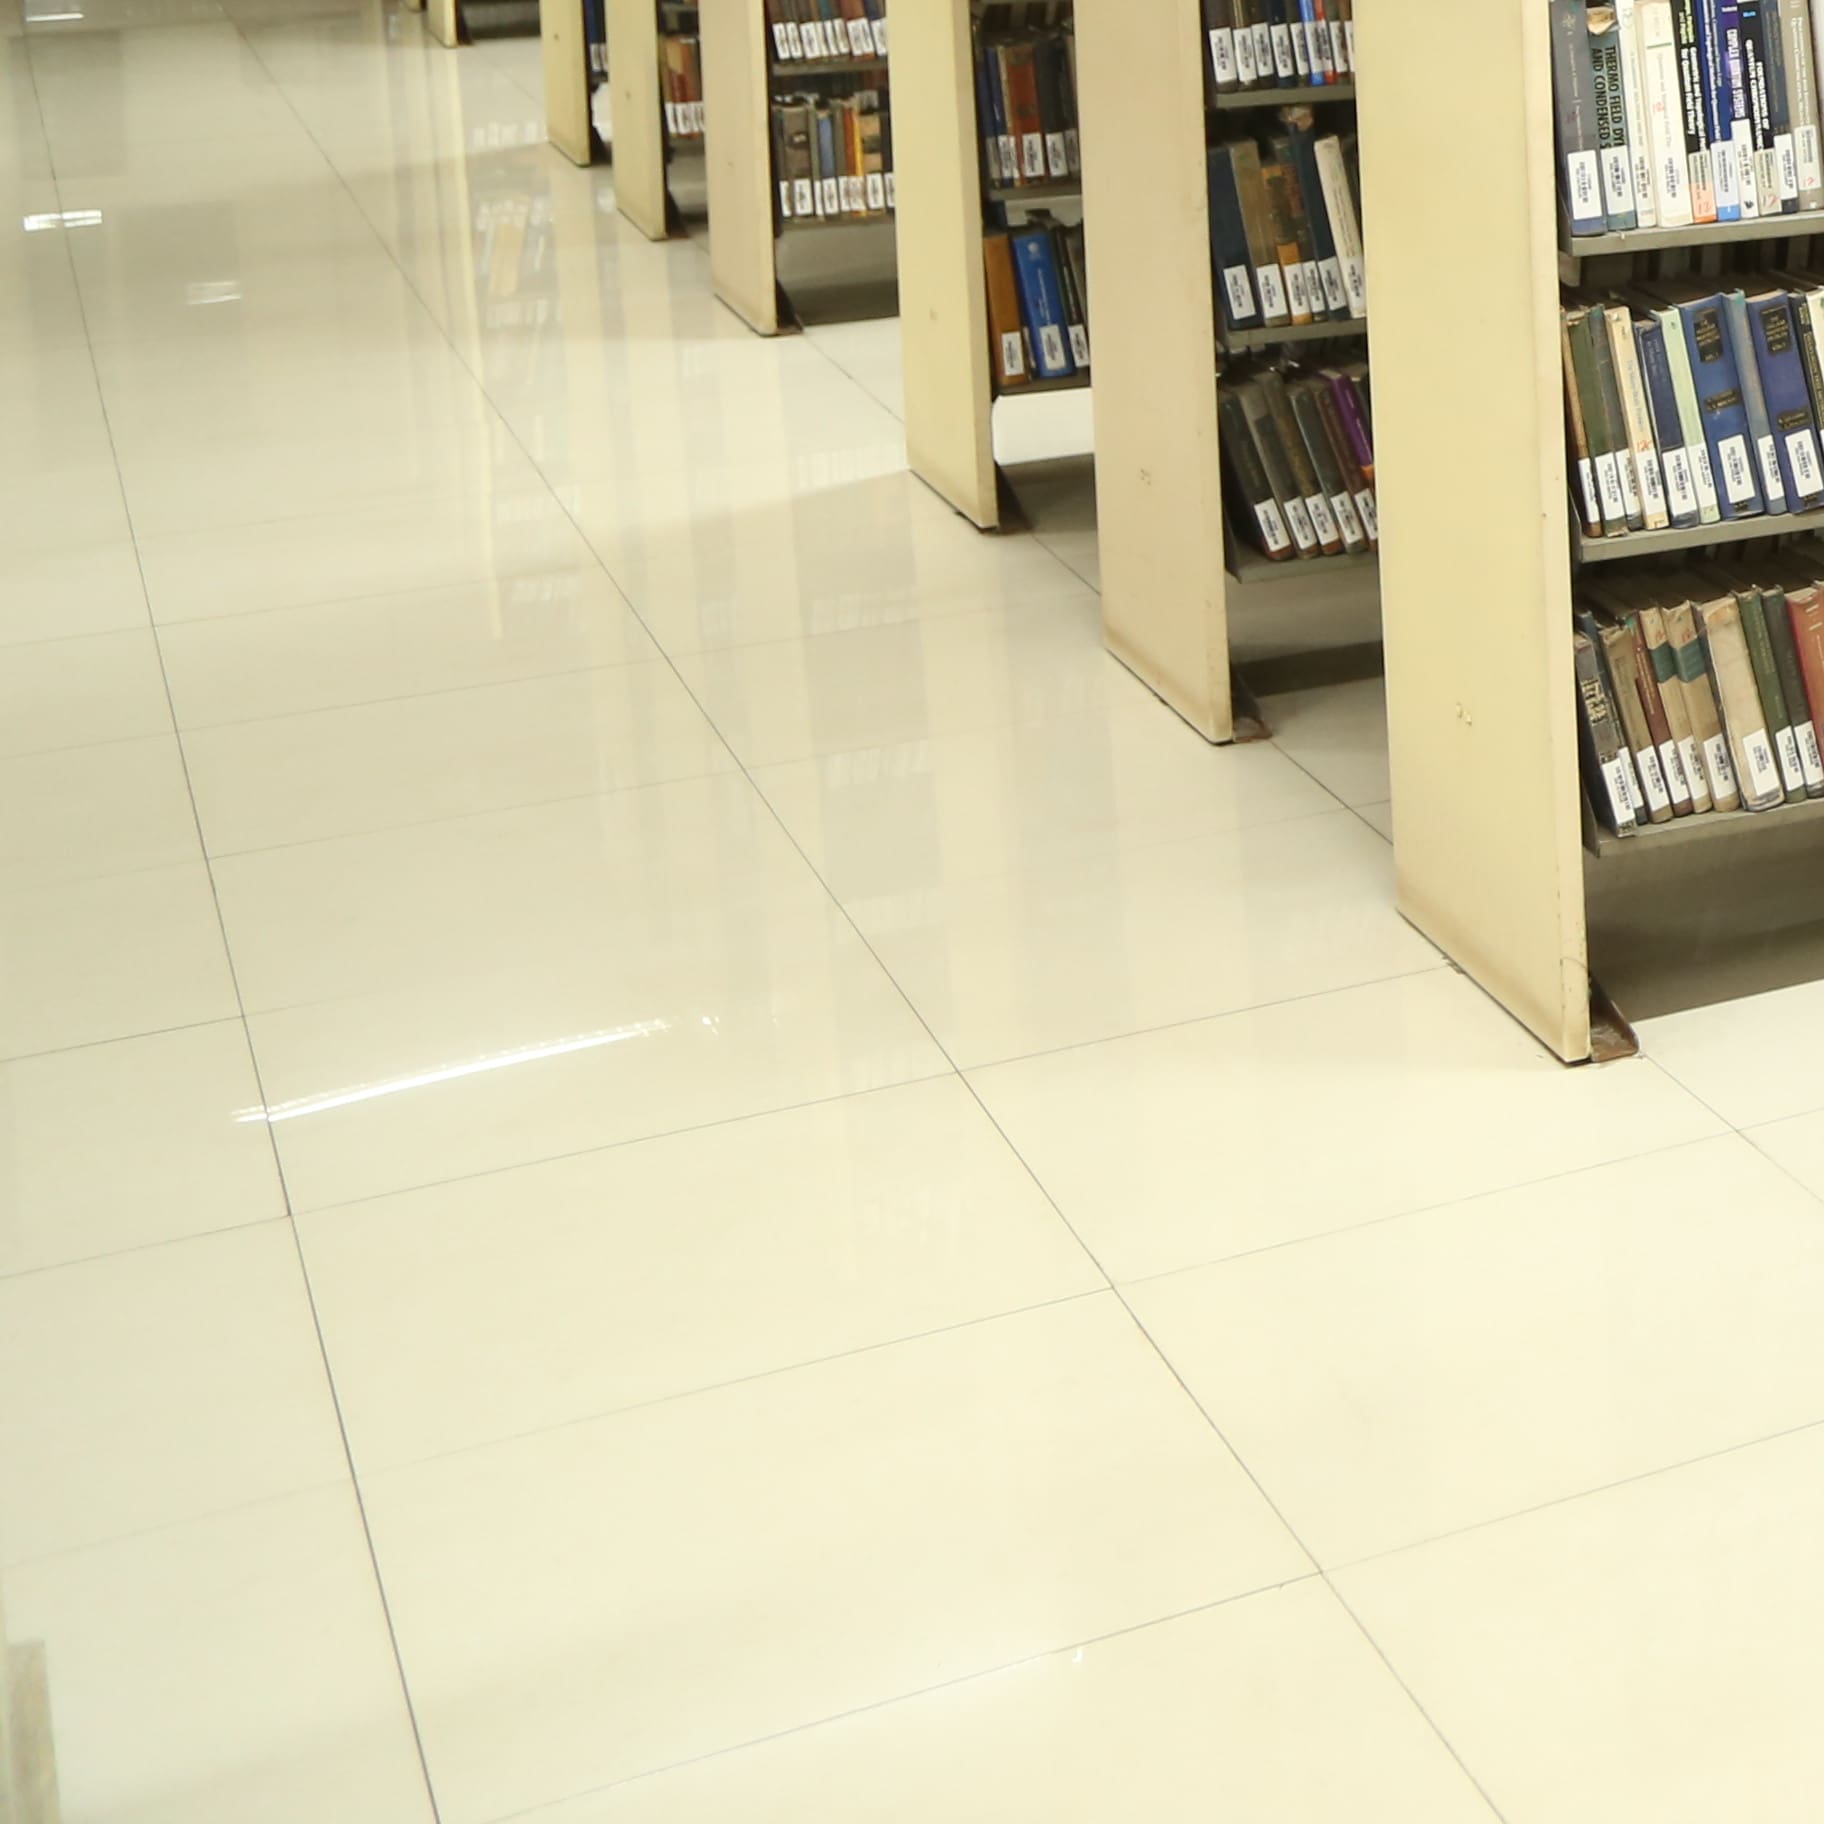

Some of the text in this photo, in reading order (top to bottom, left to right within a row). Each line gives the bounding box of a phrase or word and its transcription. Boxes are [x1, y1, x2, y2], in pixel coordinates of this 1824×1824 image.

[1591, 48, 1609, 135] AND CONDENSED
[1604, 46, 1619, 92] THERMO
[1609, 96, 1622, 125] FIELD
